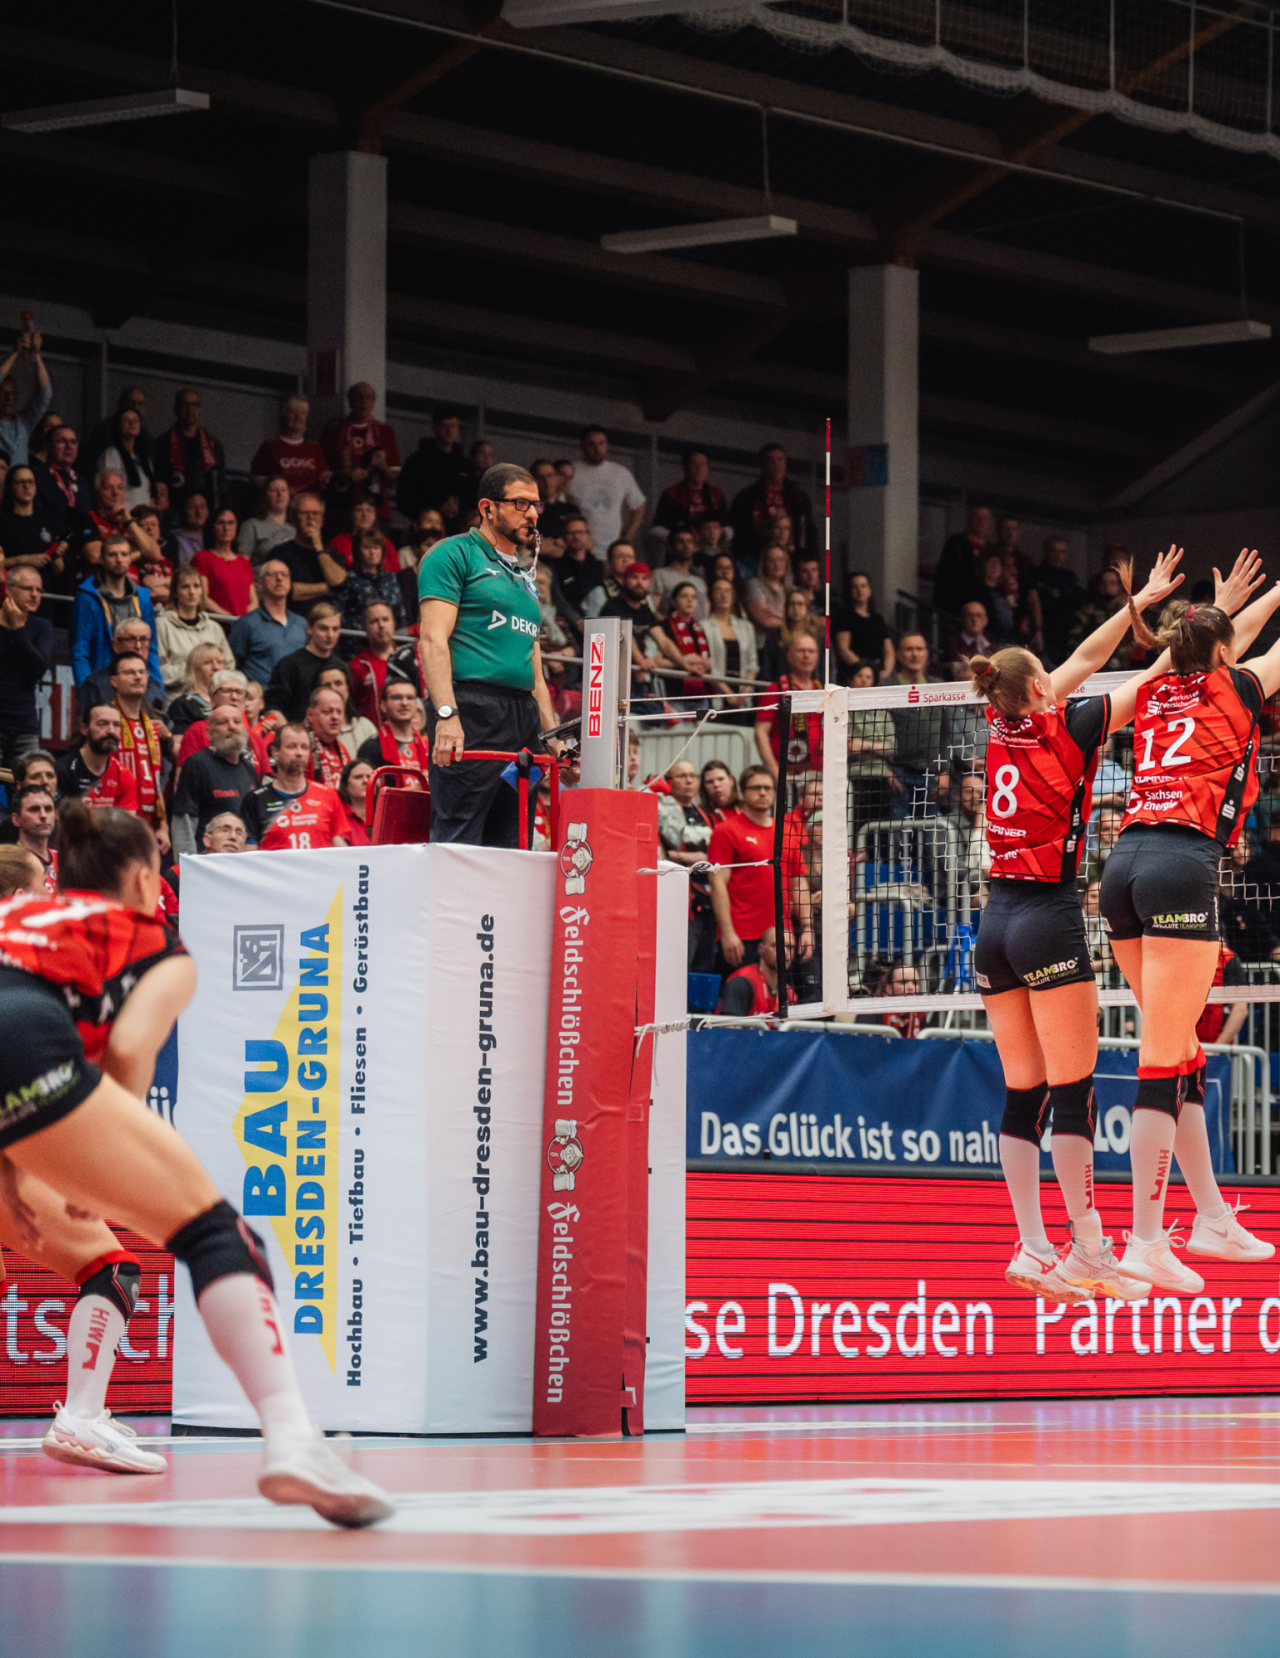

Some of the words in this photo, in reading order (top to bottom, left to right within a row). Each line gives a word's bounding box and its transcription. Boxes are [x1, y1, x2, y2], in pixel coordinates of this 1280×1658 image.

[511, 615, 540, 638] DEKR
[588, 642, 604, 737] BENZ
[923, 691, 966, 703] Sparkasse
[1138, 717, 1196, 772] 12
[991, 764, 1020, 819] 8
[1145, 790, 1183, 801] Sachsen
[288, 832, 311, 850] 18
[353, 864, 370, 994] Gerüstbau
[350, 1027, 368, 1115] Fliesen
[243, 1039, 289, 1216] BAU
[294, 923, 330, 1335] DRESDEN-GRUNA
[471, 913, 497, 1364] www.bau-dresden-gruna.de
[700, 1111, 761, 1157] Das
[768, 1113, 856, 1158] Glück
[858, 1116, 896, 1161] ist
[902, 1124, 941, 1163] so
[348, 1148, 366, 1245] Tiefbau
[346, 1278, 363, 1387] Hochbau
[767, 1280, 995, 1359] Dresden
[1036, 1295, 1242, 1356] Partner
